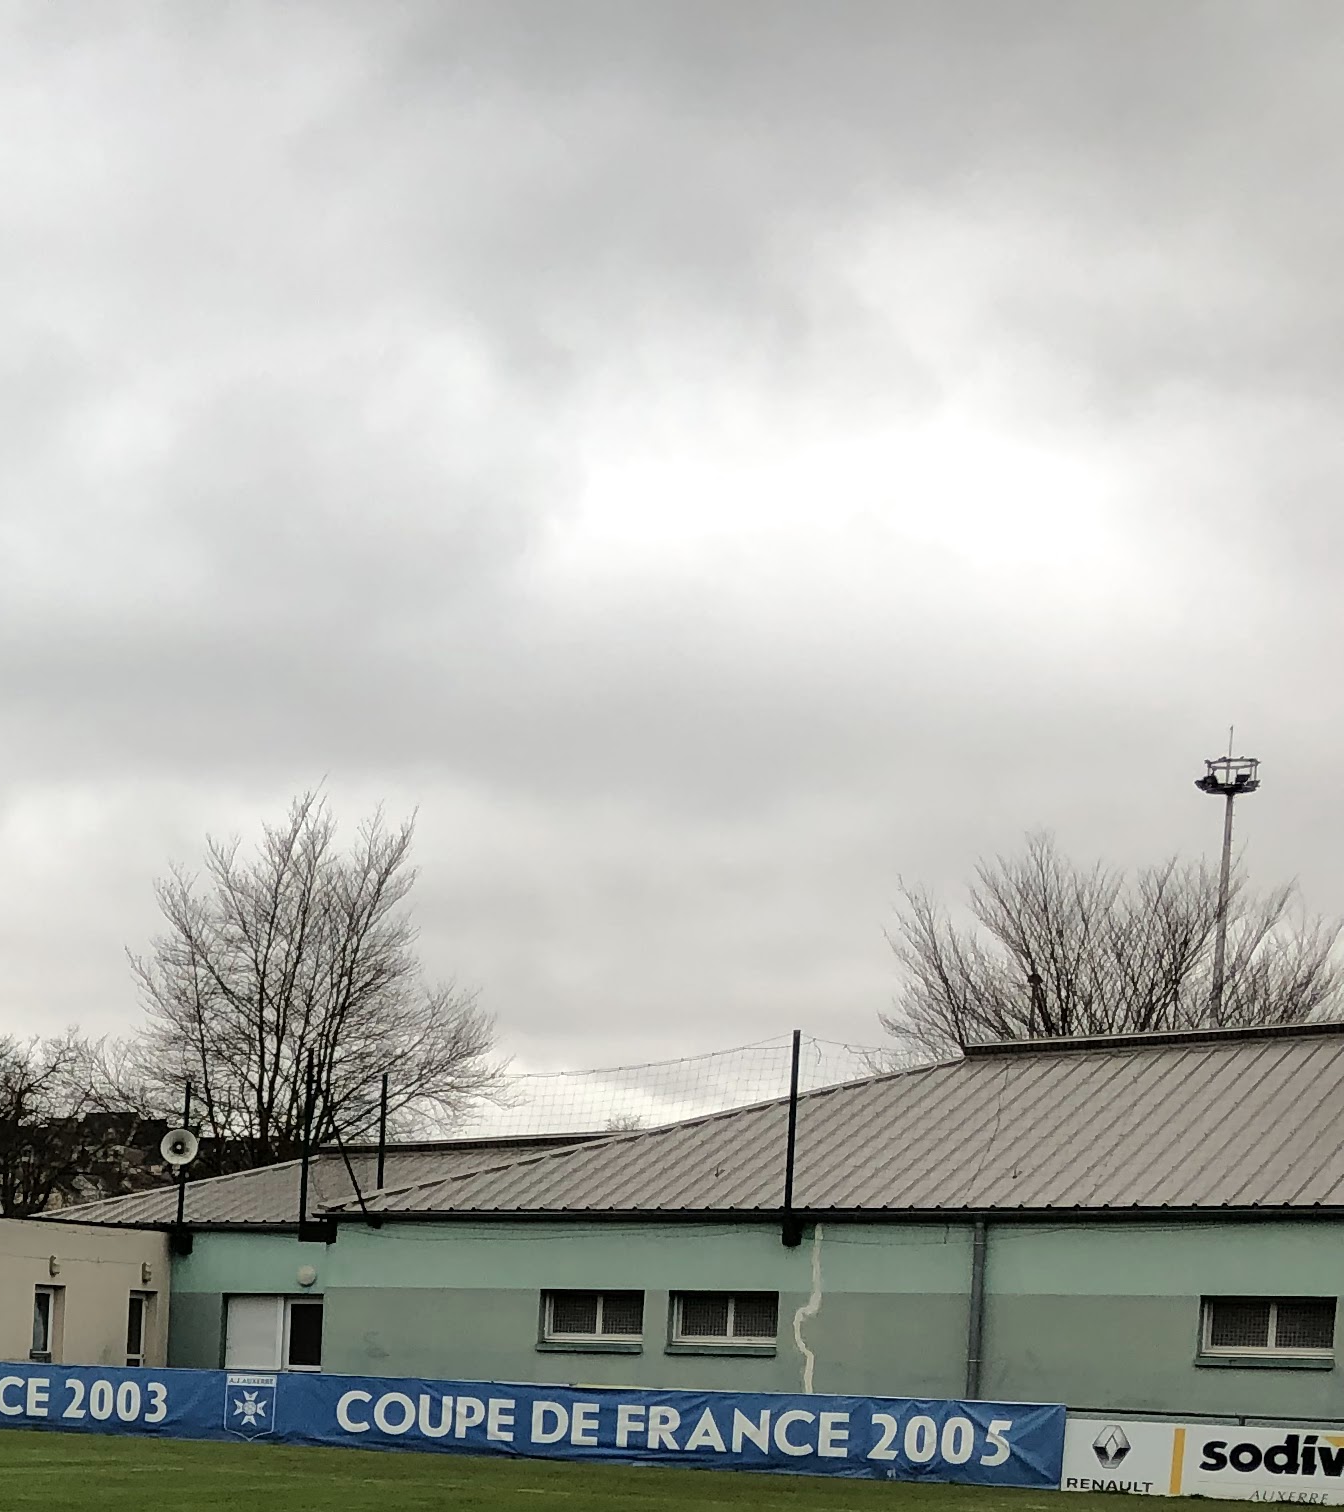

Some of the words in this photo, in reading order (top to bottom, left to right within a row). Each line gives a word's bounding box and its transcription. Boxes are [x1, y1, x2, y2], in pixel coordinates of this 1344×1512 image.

[62, 1378, 168, 1423] 2003
[336, 1390, 516, 1442] COUPE
[530, 1400, 600, 1446] DE
[615, 1404, 850, 1458] FRANCE
[866, 1413, 1013, 1467] 2005
[1066, 1477, 1154, 1493] RENAULT
[1249, 1490, 1329, 1503] AUXERRE
